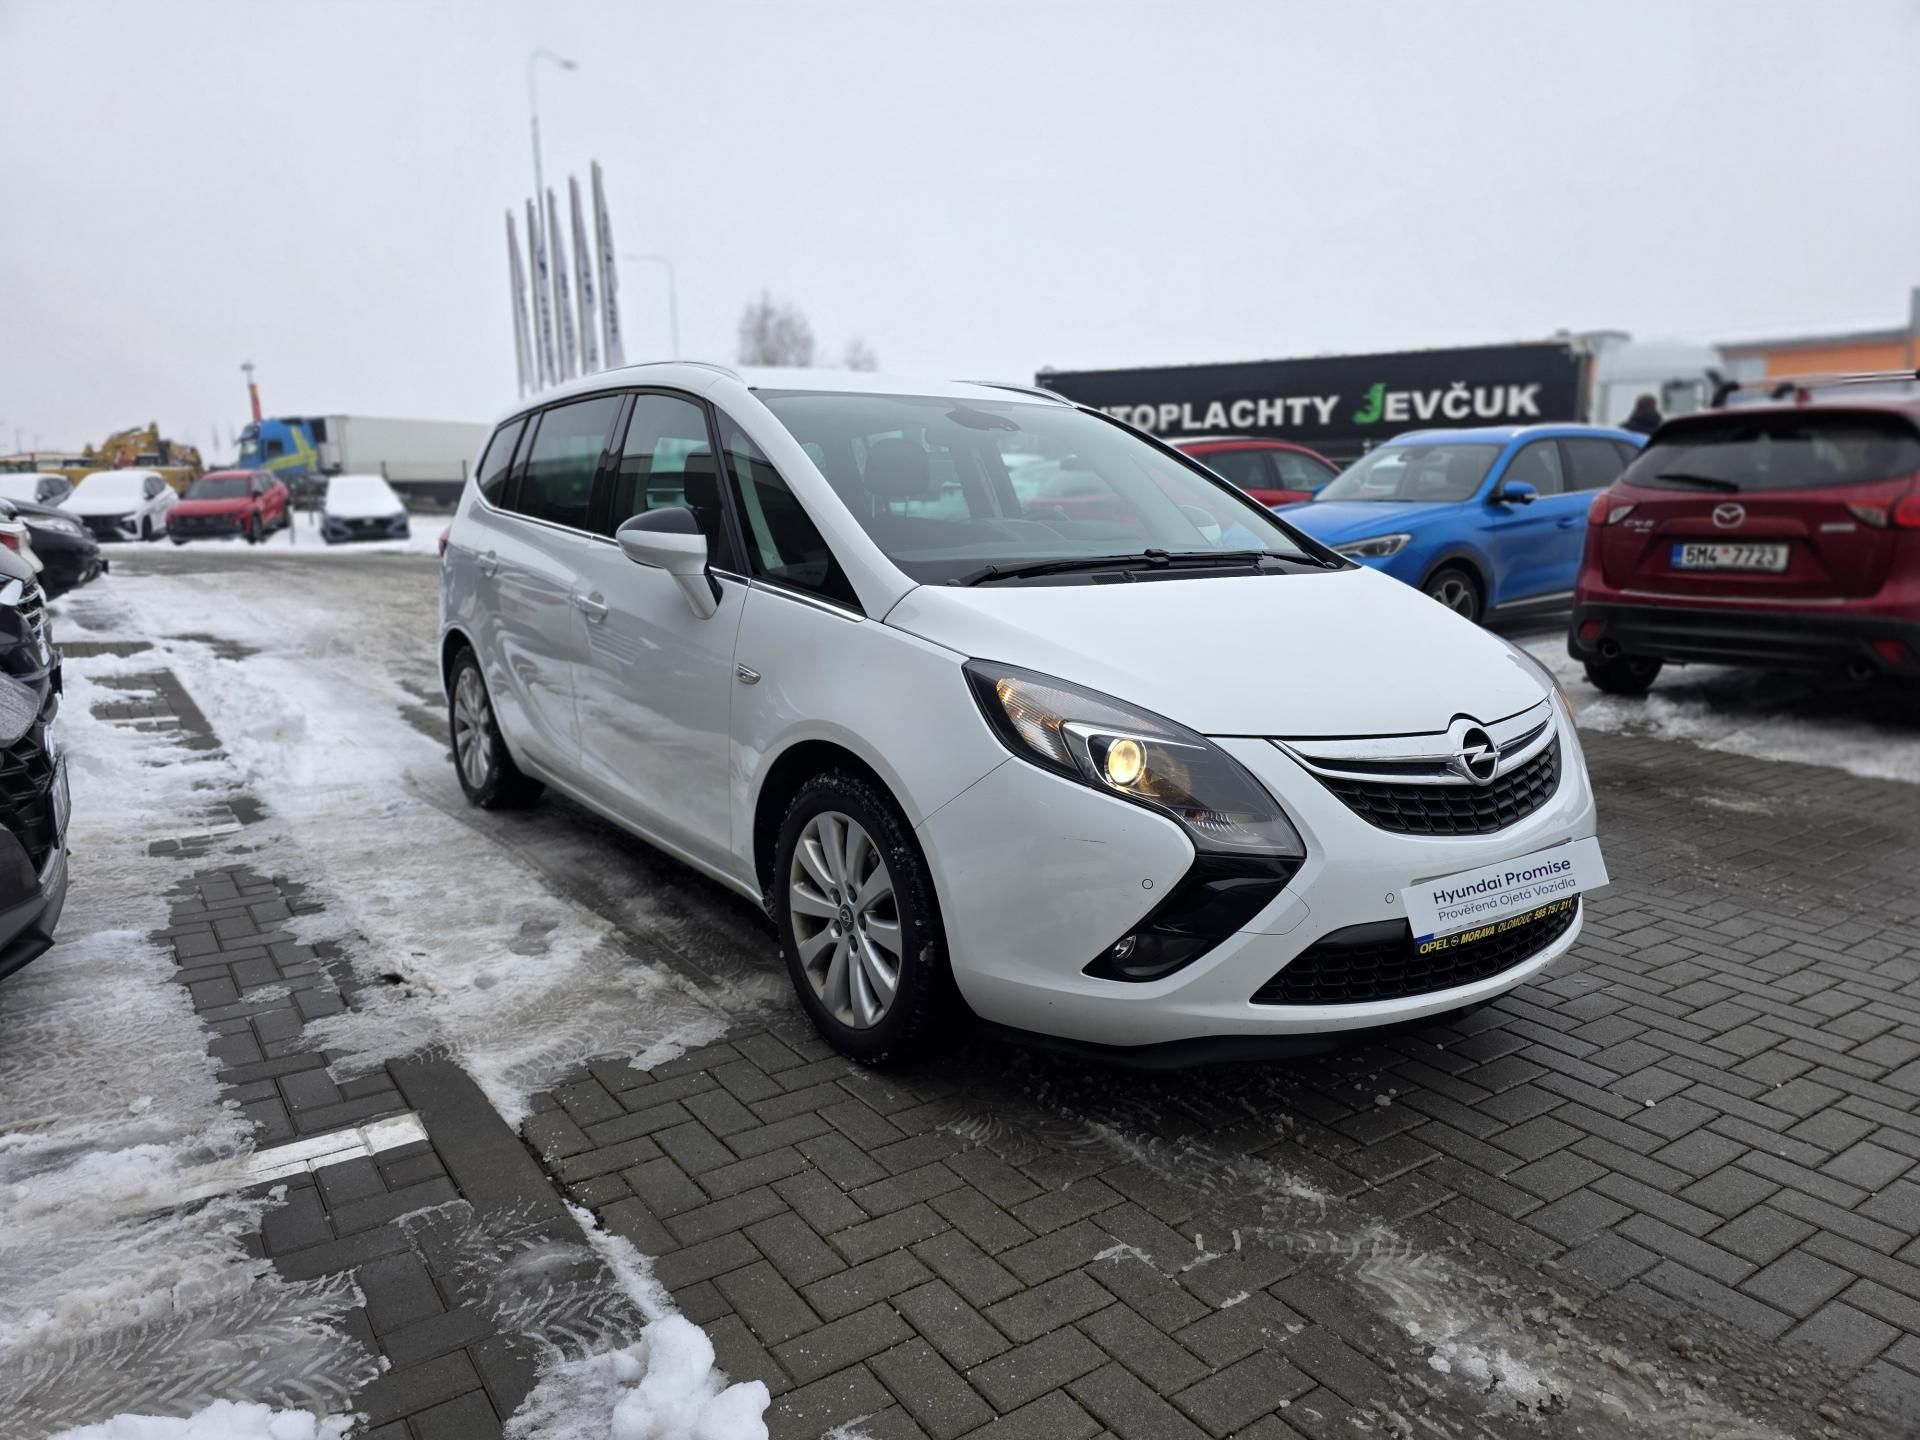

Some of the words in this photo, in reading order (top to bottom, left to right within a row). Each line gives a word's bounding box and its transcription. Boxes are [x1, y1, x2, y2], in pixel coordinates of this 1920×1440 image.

[1100, 396, 1340, 431] TOPLACHTY
[1353, 382, 1542, 424] JEVČUK
[1433, 875, 1502, 905] Hyundai
[1505, 860, 1571, 885] Promise
[1438, 898, 1498, 920] Prověřená
[1500, 889, 1531, 906] Ojetá
[1533, 878, 1576, 896] Vozidla
[1420, 939, 1449, 954] OPEL
[1461, 925, 1495, 944] MORAVA
[1498, 913, 1532, 932] OLOMOUC
